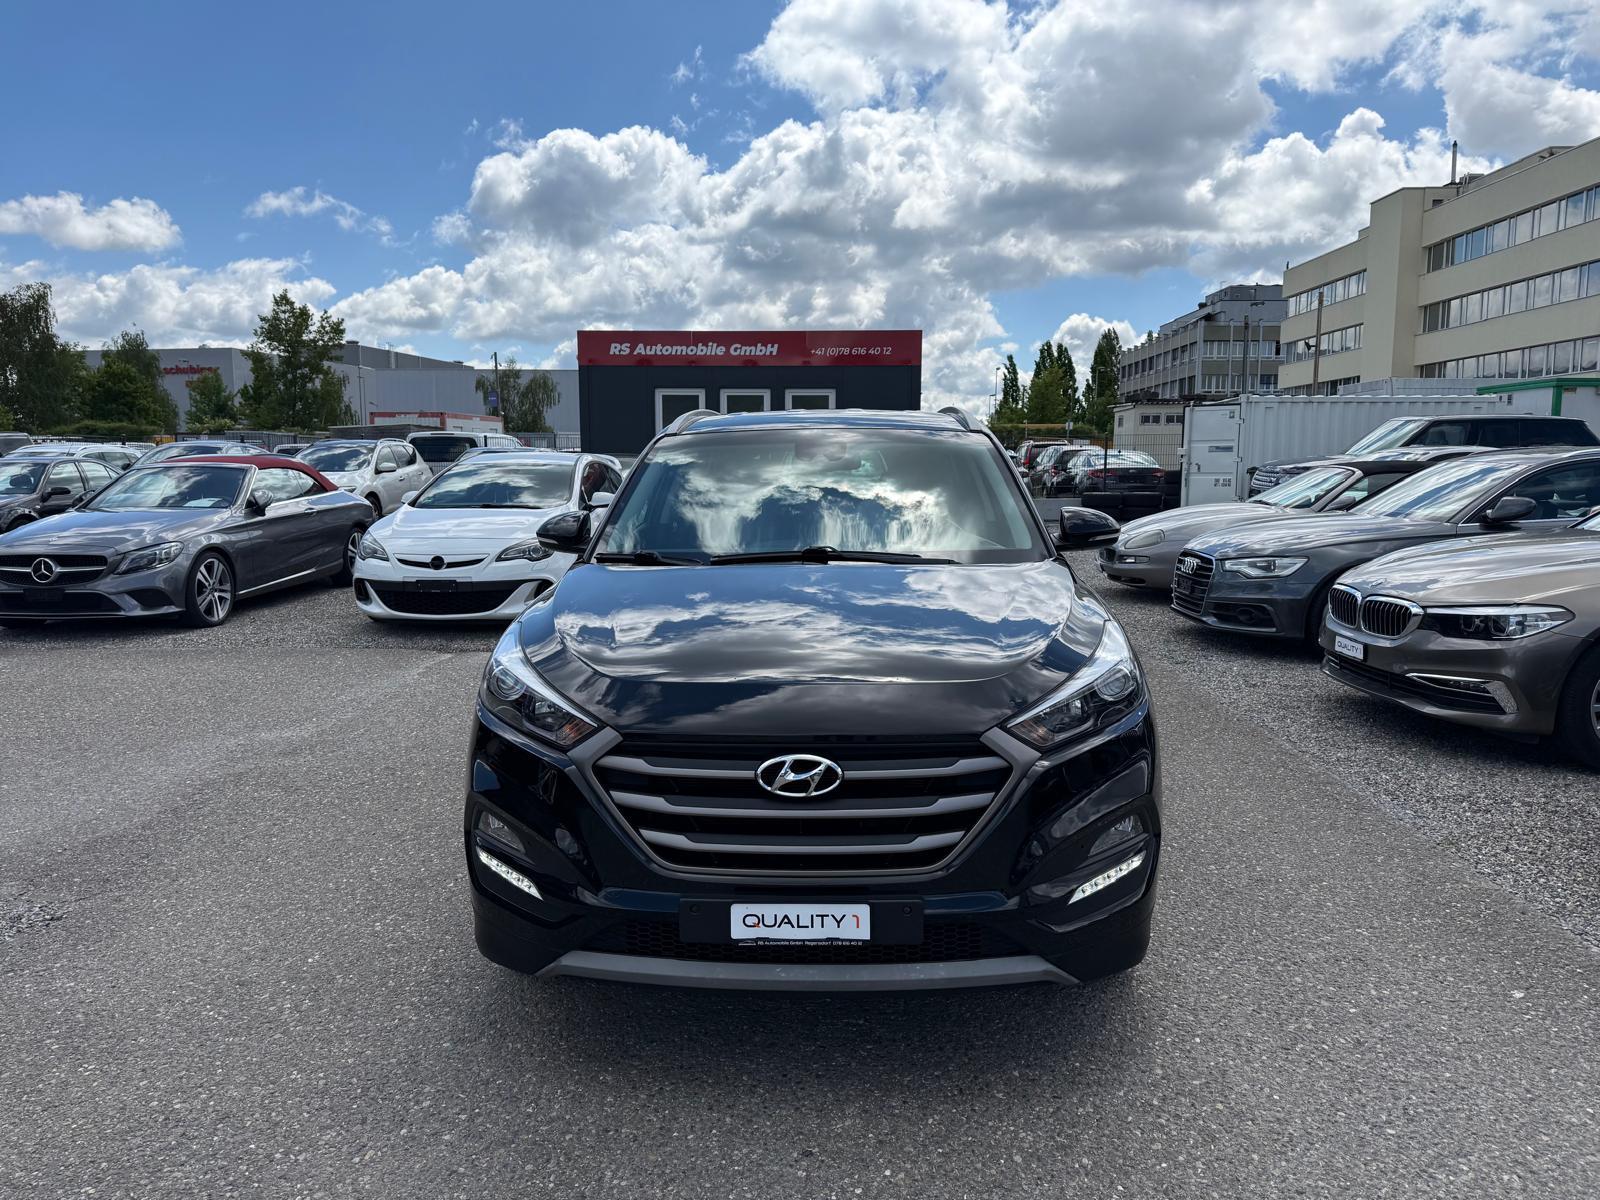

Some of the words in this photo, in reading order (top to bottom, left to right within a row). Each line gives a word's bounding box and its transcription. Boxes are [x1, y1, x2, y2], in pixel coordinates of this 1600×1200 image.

[609, 343, 631, 355] RS
[634, 342, 726, 356] Automobile
[730, 343, 779, 356] GmbH
[810, 347, 825, 356] +41
[826, 347, 850, 357] (0)78
[851, 347, 867, 355] 616
[868, 347, 881, 355] 40
[883, 347, 892, 355] 12
[1337, 640, 1359, 653] QUALITY
[742, 913, 847, 929] QUALITY
[851, 914, 860, 929] 1
